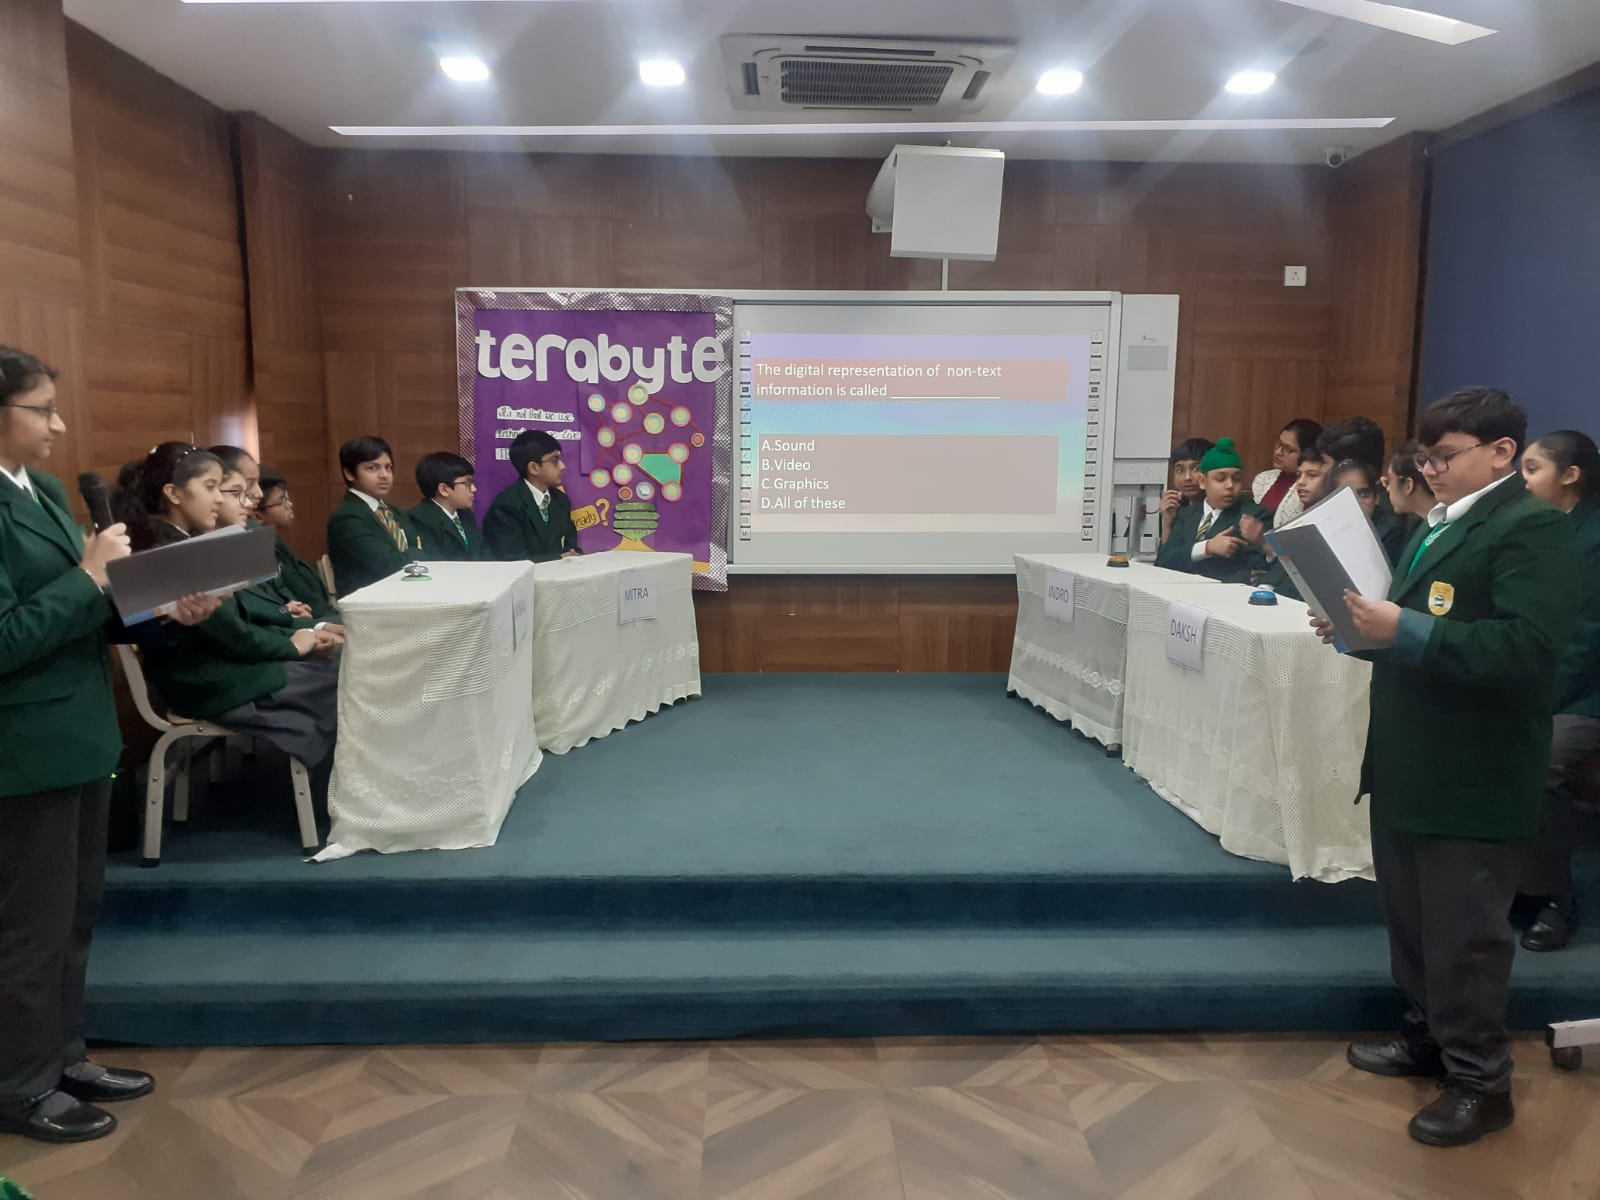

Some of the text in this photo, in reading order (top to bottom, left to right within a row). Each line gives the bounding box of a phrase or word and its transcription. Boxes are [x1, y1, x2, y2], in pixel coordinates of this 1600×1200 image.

[475, 329, 725, 394] terabyte
[756, 363, 1002, 379] The digital representation of non-text
[757, 383, 887, 396] information is called
[761, 439, 815, 452] A.Sound
[762, 458, 811, 471] B.Video
[761, 478, 829, 492] C.Graphics
[761, 496, 846, 509] D.All of these
[624, 587, 649, 601] MITRA
[1170, 619, 1197, 645] DAKSH
